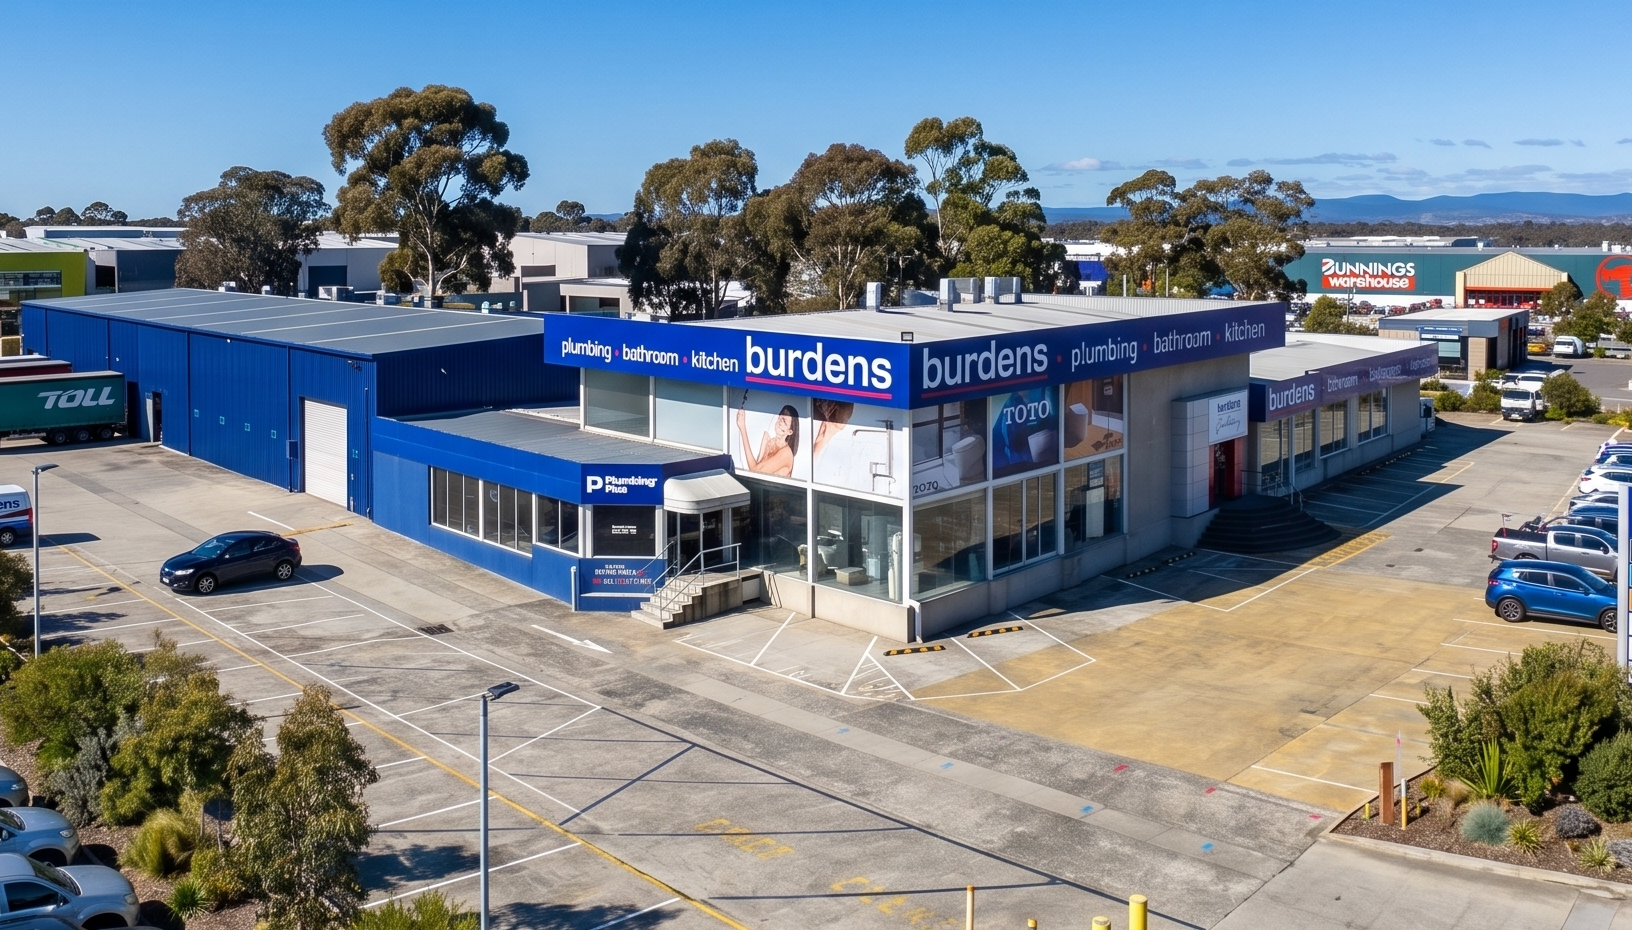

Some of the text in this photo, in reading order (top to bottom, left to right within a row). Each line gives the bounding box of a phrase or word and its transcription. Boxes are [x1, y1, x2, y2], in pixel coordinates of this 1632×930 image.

[1322, 258, 1415, 276] BUNNINGS
[562, 335, 892, 389] plumbing bathroom kitchen burdens
[922, 319, 1266, 389] burdens plumbing bathroom kitchen
[37, 386, 116, 410] TOLL
[1268, 383, 1315, 411] burdens
[1003, 399, 1050, 425] TOTO
